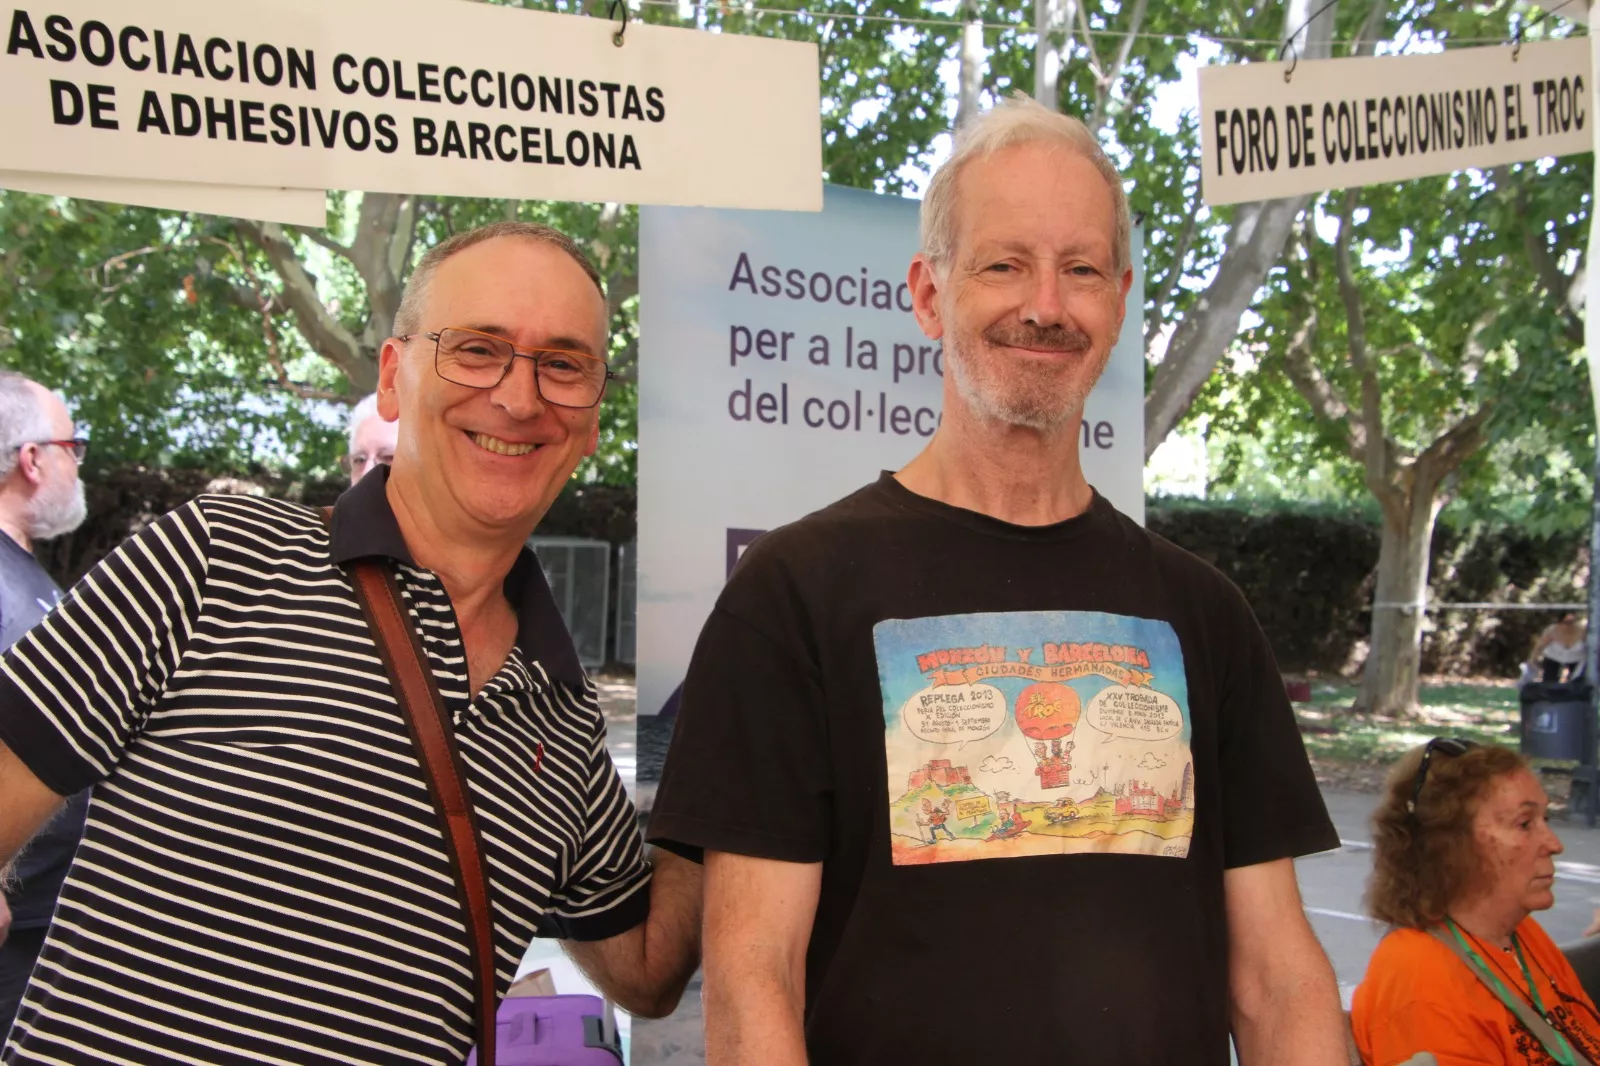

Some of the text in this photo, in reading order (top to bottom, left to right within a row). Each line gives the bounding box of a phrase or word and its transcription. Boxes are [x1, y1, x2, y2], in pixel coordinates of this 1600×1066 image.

[7, 9, 666, 123] ASOCIACION COLECCIONISTAS
[49, 79, 642, 171] DE ADHESIVOS BARCELONA
[1214, 74, 1585, 176] FORO DE COLECCIONISMO EL TROC
[728, 252, 914, 313] Associac
[729, 324, 795, 366] per
[808, 334, 829, 366] a
[846, 326, 878, 371] la
[727, 379, 789, 425] del
[916, 642, 1150, 674] MONZÓN Y BARCELONA
[975, 663, 1125, 680] CIUDADES HERMANADAS
[920, 689, 994, 707] REPLEGA 2013
[1106, 692, 1158, 704] XXV TROBADA
